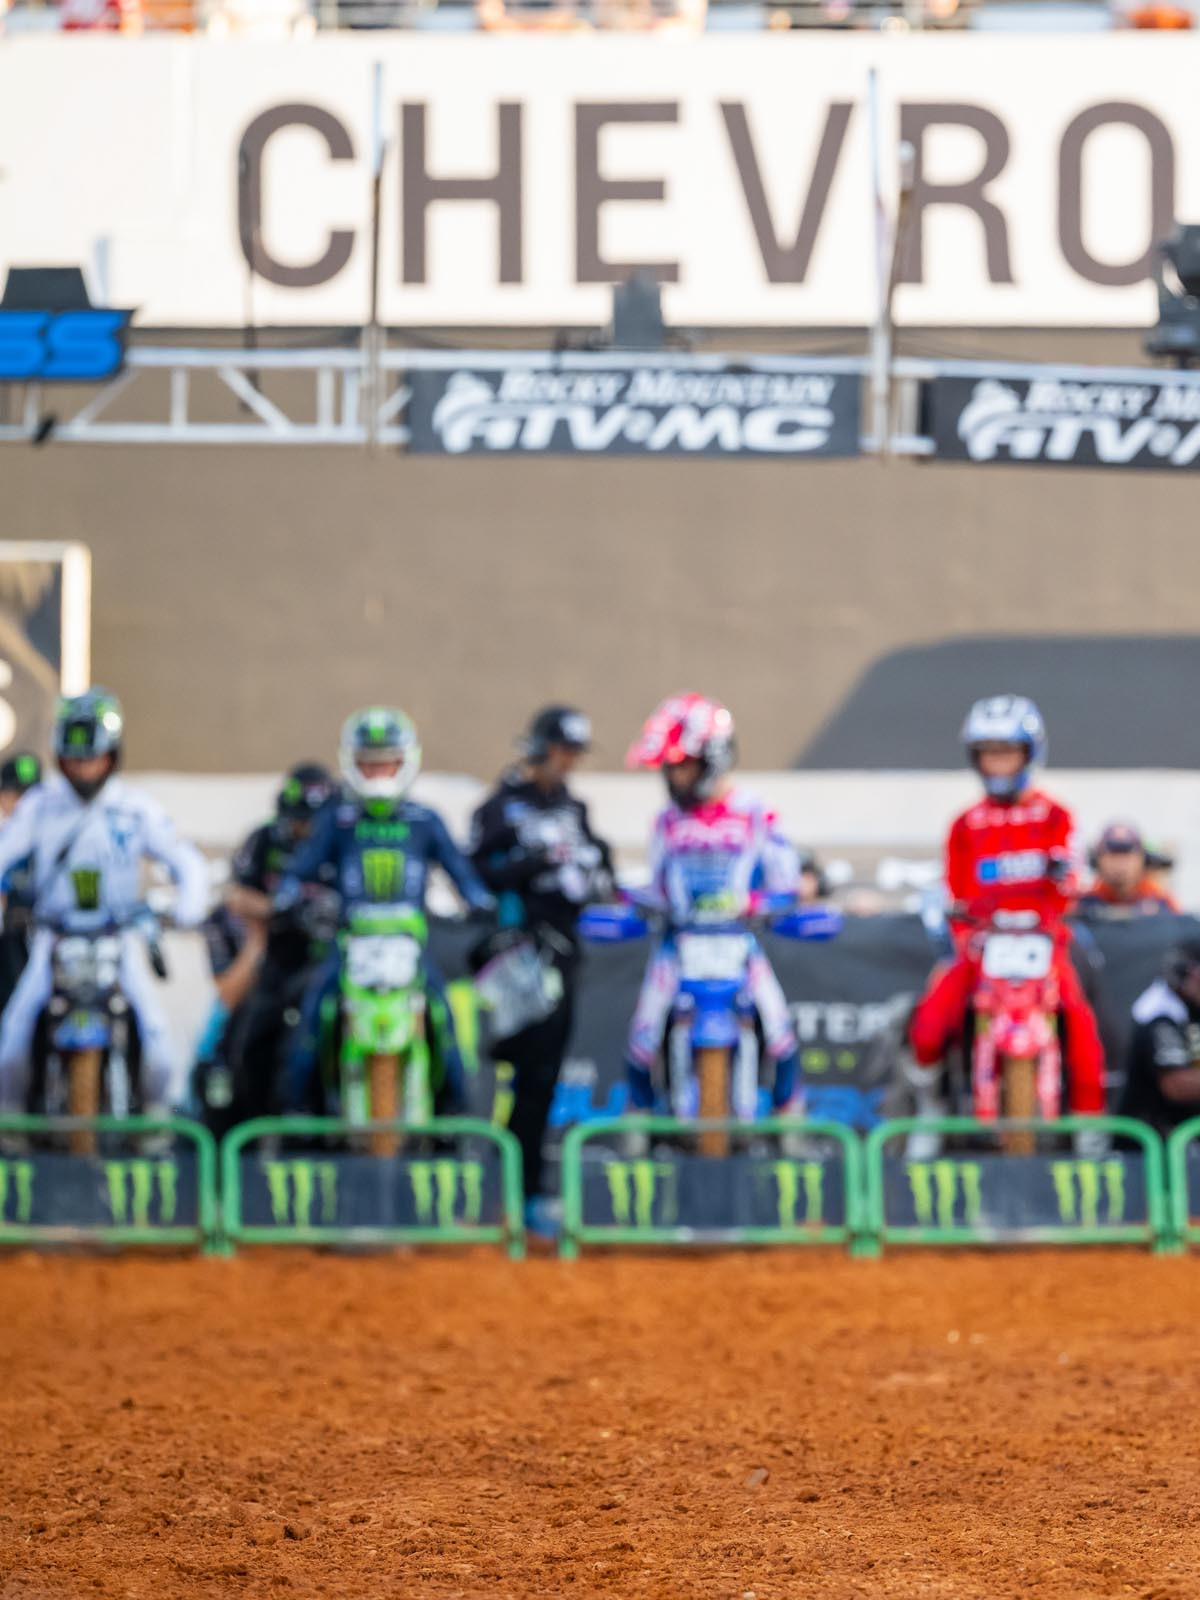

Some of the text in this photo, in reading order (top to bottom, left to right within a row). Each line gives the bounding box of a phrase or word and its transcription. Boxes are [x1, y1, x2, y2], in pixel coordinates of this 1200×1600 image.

[497, 369, 834, 406] ROCKY MOUNTAIN
[1023, 378, 1151, 418] ROCKY
